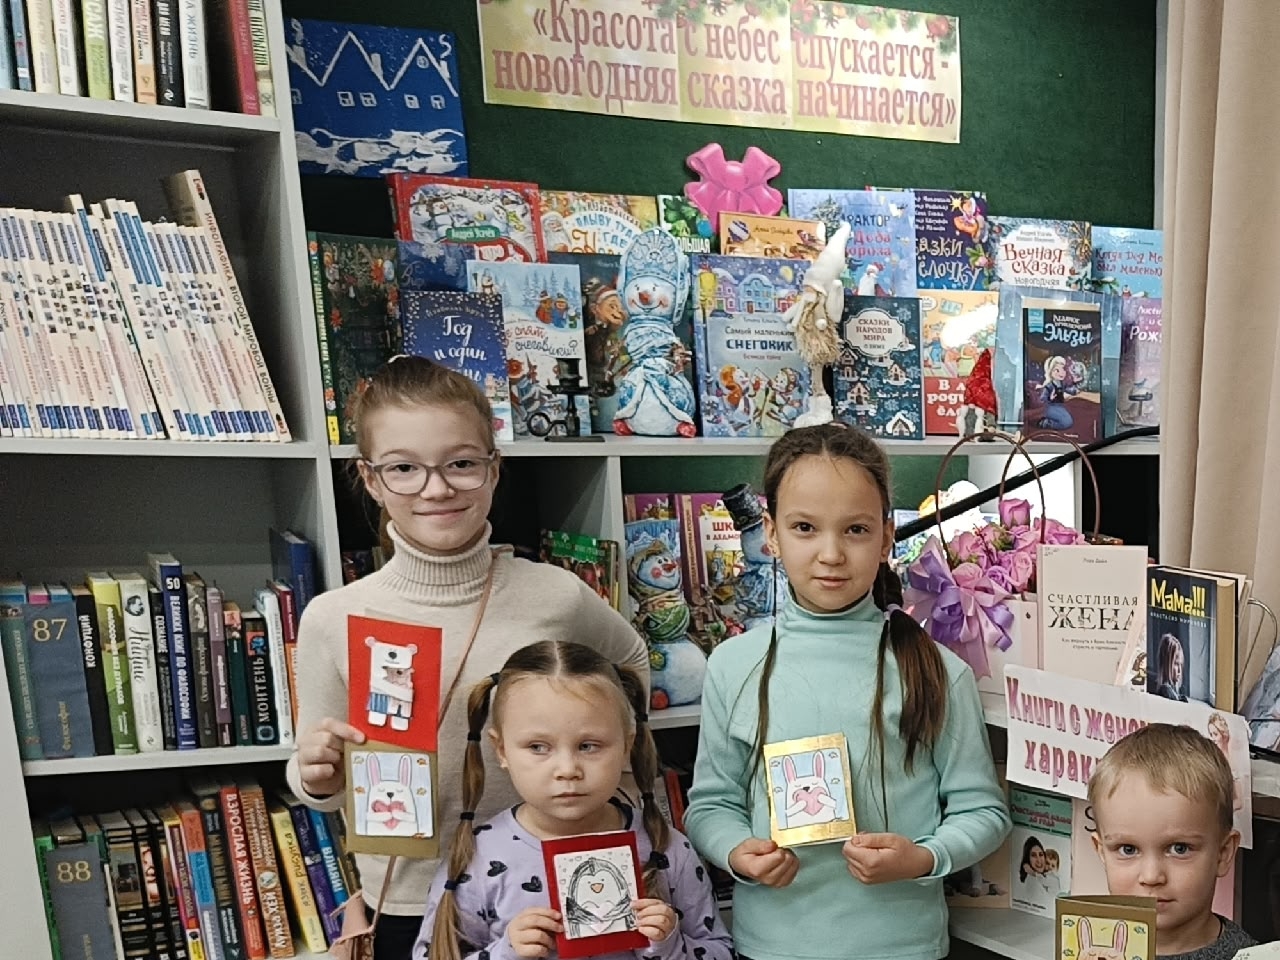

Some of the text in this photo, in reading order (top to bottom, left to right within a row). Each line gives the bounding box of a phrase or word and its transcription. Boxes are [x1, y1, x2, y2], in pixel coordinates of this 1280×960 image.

[704, 21, 781, 63] небес
[492, 49, 678, 113] новогодняя
[687, 72, 787, 115] сказка
[677, 236, 711, 254] ОЛЬШАЯ
[1001, 243, 1063, 263] Вечная
[1012, 260, 1065, 276] сказка
[442, 316, 473, 347] Год
[855, 326, 893, 335] НАРОДОВ
[858, 318, 890, 327] СКАЗКИ
[726, 338, 794, 352] СНЕГОВИК
[863, 334, 886, 342] МИРА
[449, 348, 487, 367] один
[165, 577, 181, 590] 50
[1047, 593, 1138, 606] СЧАСТЛИВАЯ
[32, 618, 68, 642] 87
[79, 614, 96, 668] КОНФУЦИЙ
[252, 657, 271, 724] МОНТЕНЬ
[1006, 676, 1066, 733] Книги
[1069, 704, 1081, 735] с
[226, 793, 255, 905] ВЗРОСЛАЯ ЖИЗНЬ
[57, 861, 91, 883] 88
